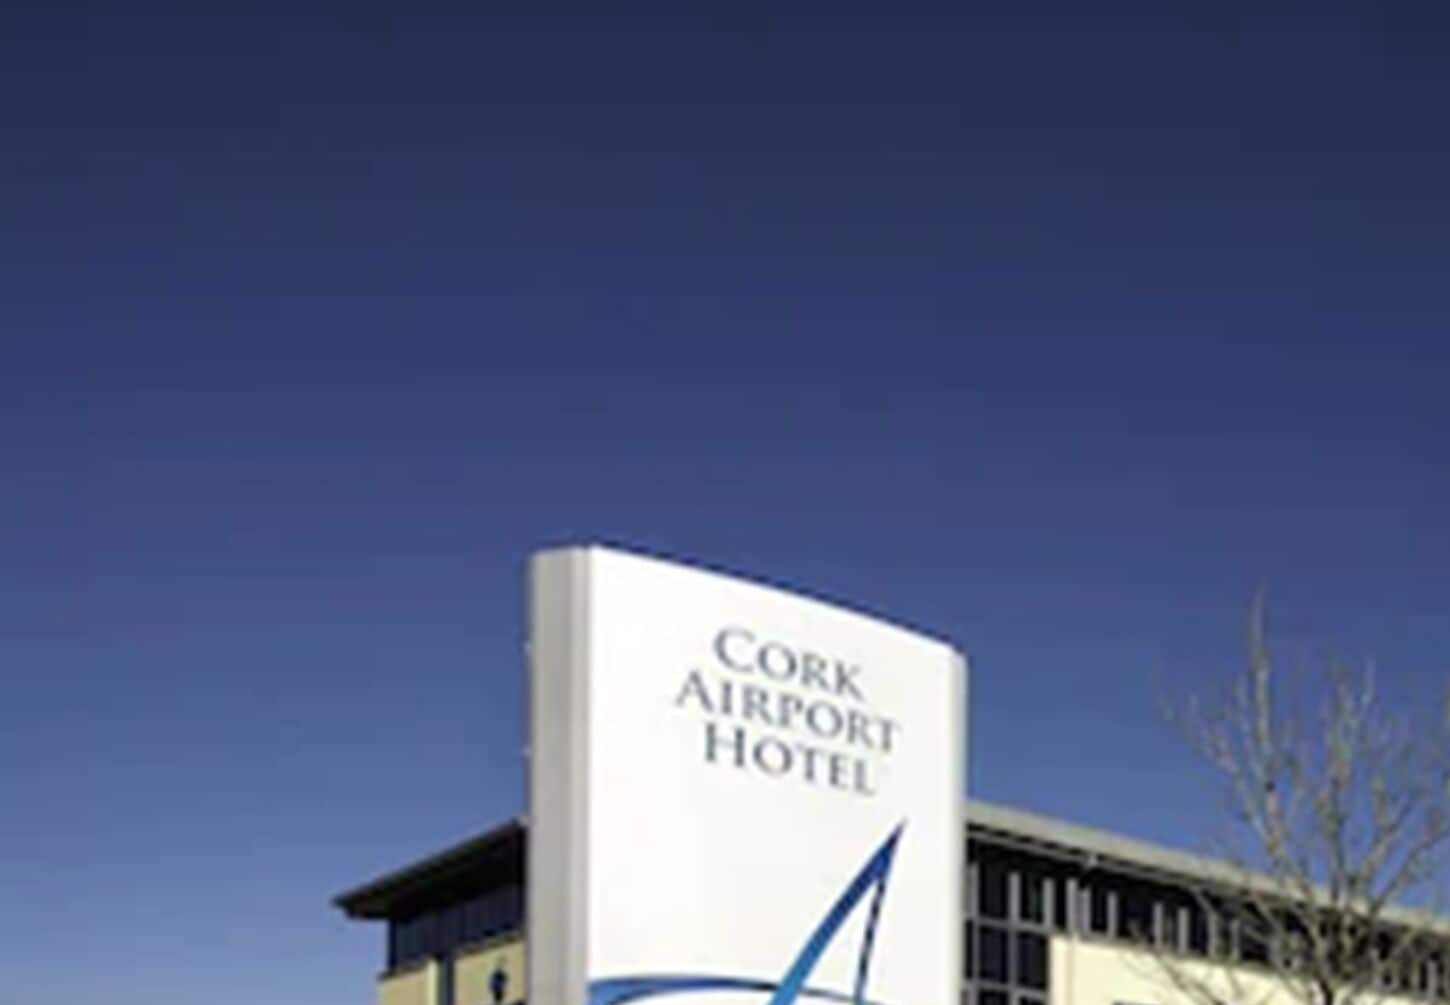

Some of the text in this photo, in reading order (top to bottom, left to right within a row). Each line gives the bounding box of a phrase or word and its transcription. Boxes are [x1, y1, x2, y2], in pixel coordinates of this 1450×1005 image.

[713, 625, 864, 702] CORK
[674, 668, 901, 755] AIRPORT
[703, 721, 877, 798] HOTEL
